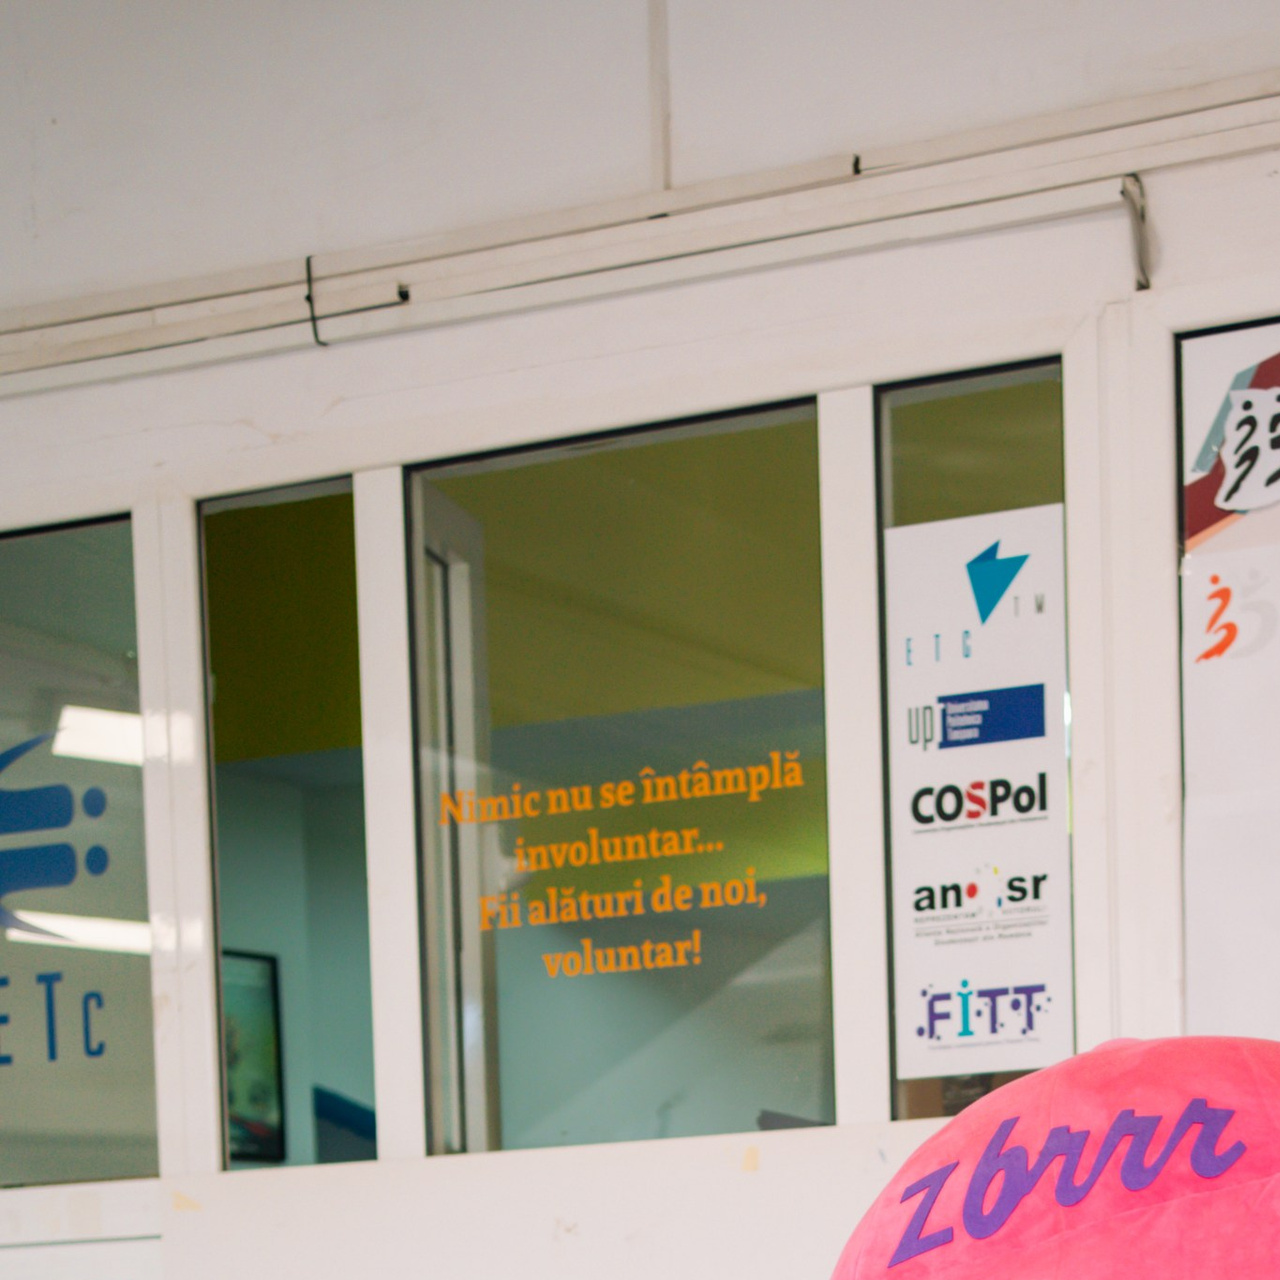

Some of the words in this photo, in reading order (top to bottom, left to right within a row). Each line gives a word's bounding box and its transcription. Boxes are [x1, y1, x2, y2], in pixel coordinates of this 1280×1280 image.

[440, 783, 540, 825] Nimic
[548, 785, 593, 815] nu
[601, 780, 635, 809] se
[639, 751, 803, 803] întâmplă
[912, 772, 1047, 824] COSPol
[515, 827, 724, 873] involuntar...
[479, 892, 522, 931] Fii
[528, 879, 645, 925] alături
[652, 875, 692, 913] de
[699, 866, 767, 909] noi,
[542, 929, 702, 979] voluntar!
